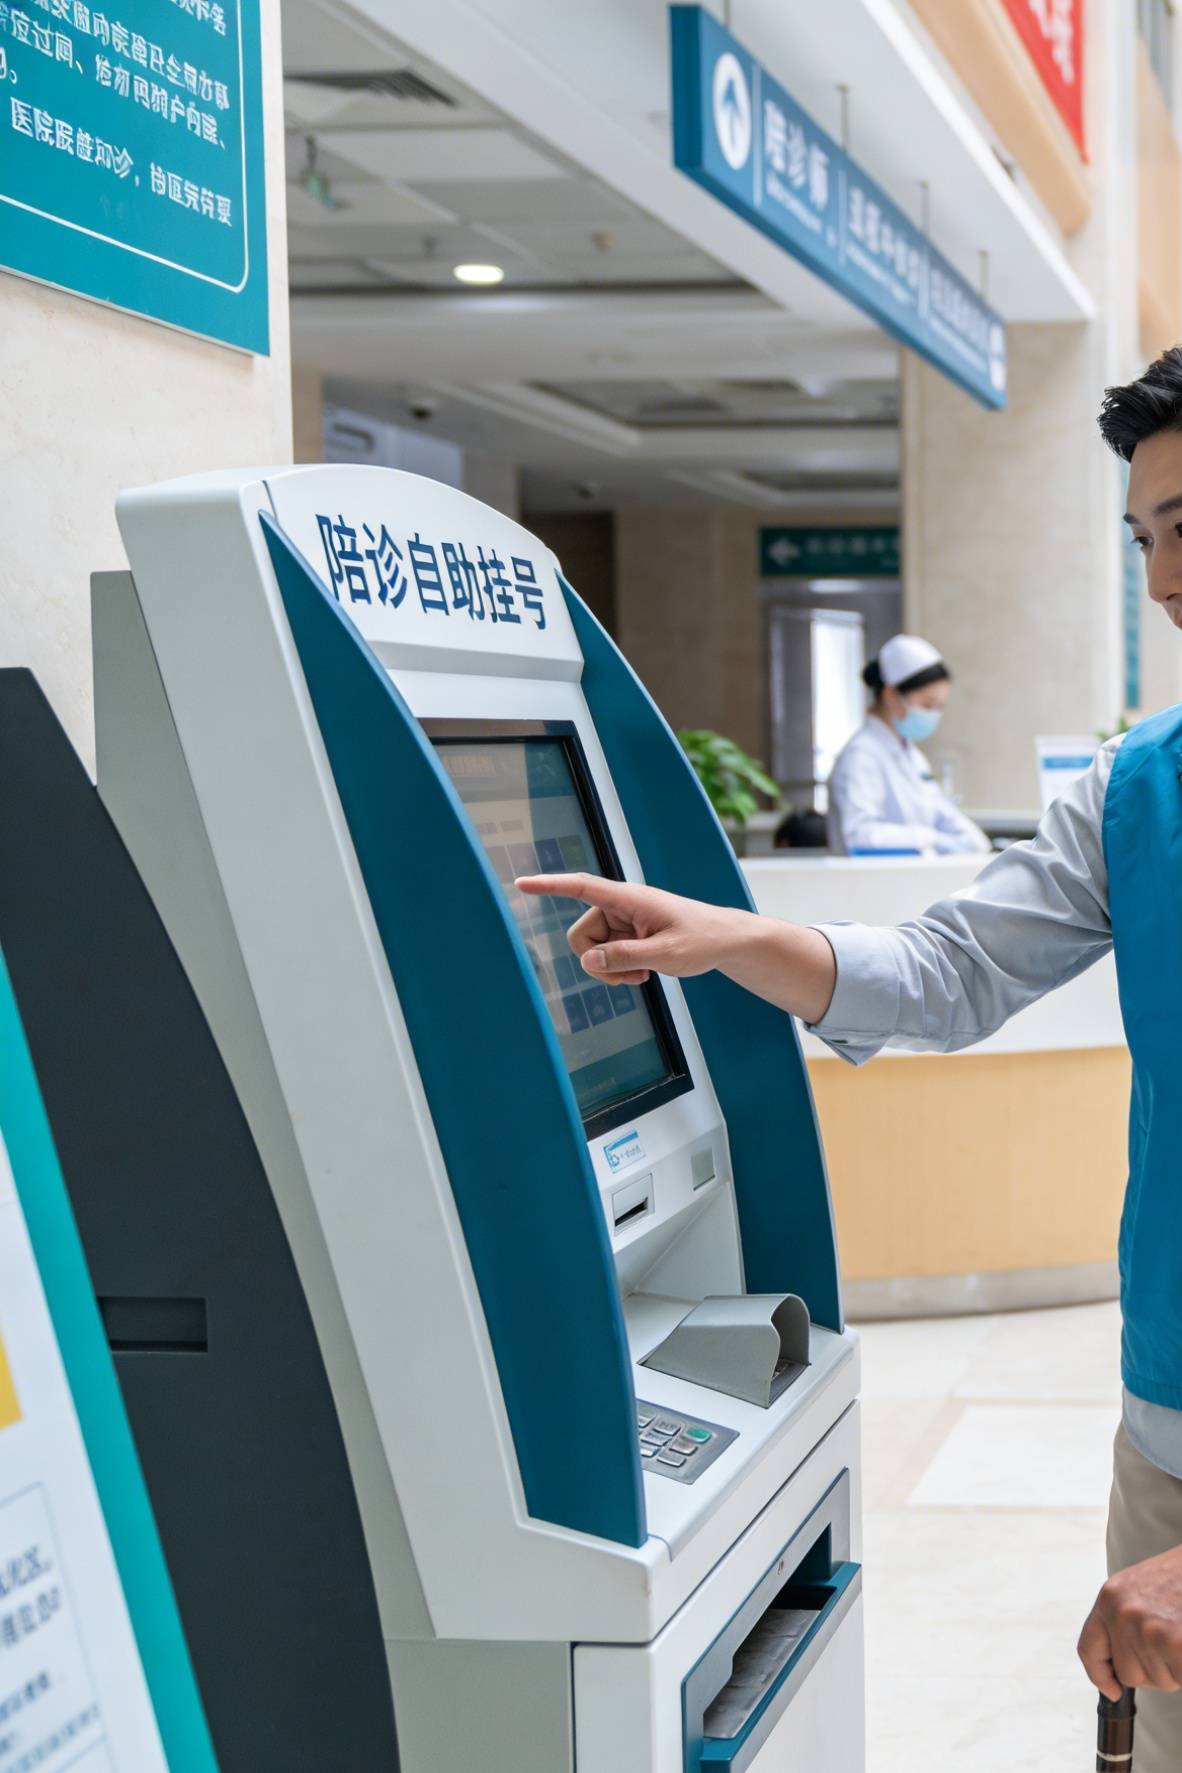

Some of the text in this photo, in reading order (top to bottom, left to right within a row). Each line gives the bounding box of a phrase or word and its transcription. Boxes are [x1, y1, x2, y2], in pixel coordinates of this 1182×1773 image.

[315, 514, 546, 630] 陪诊自助挂号
